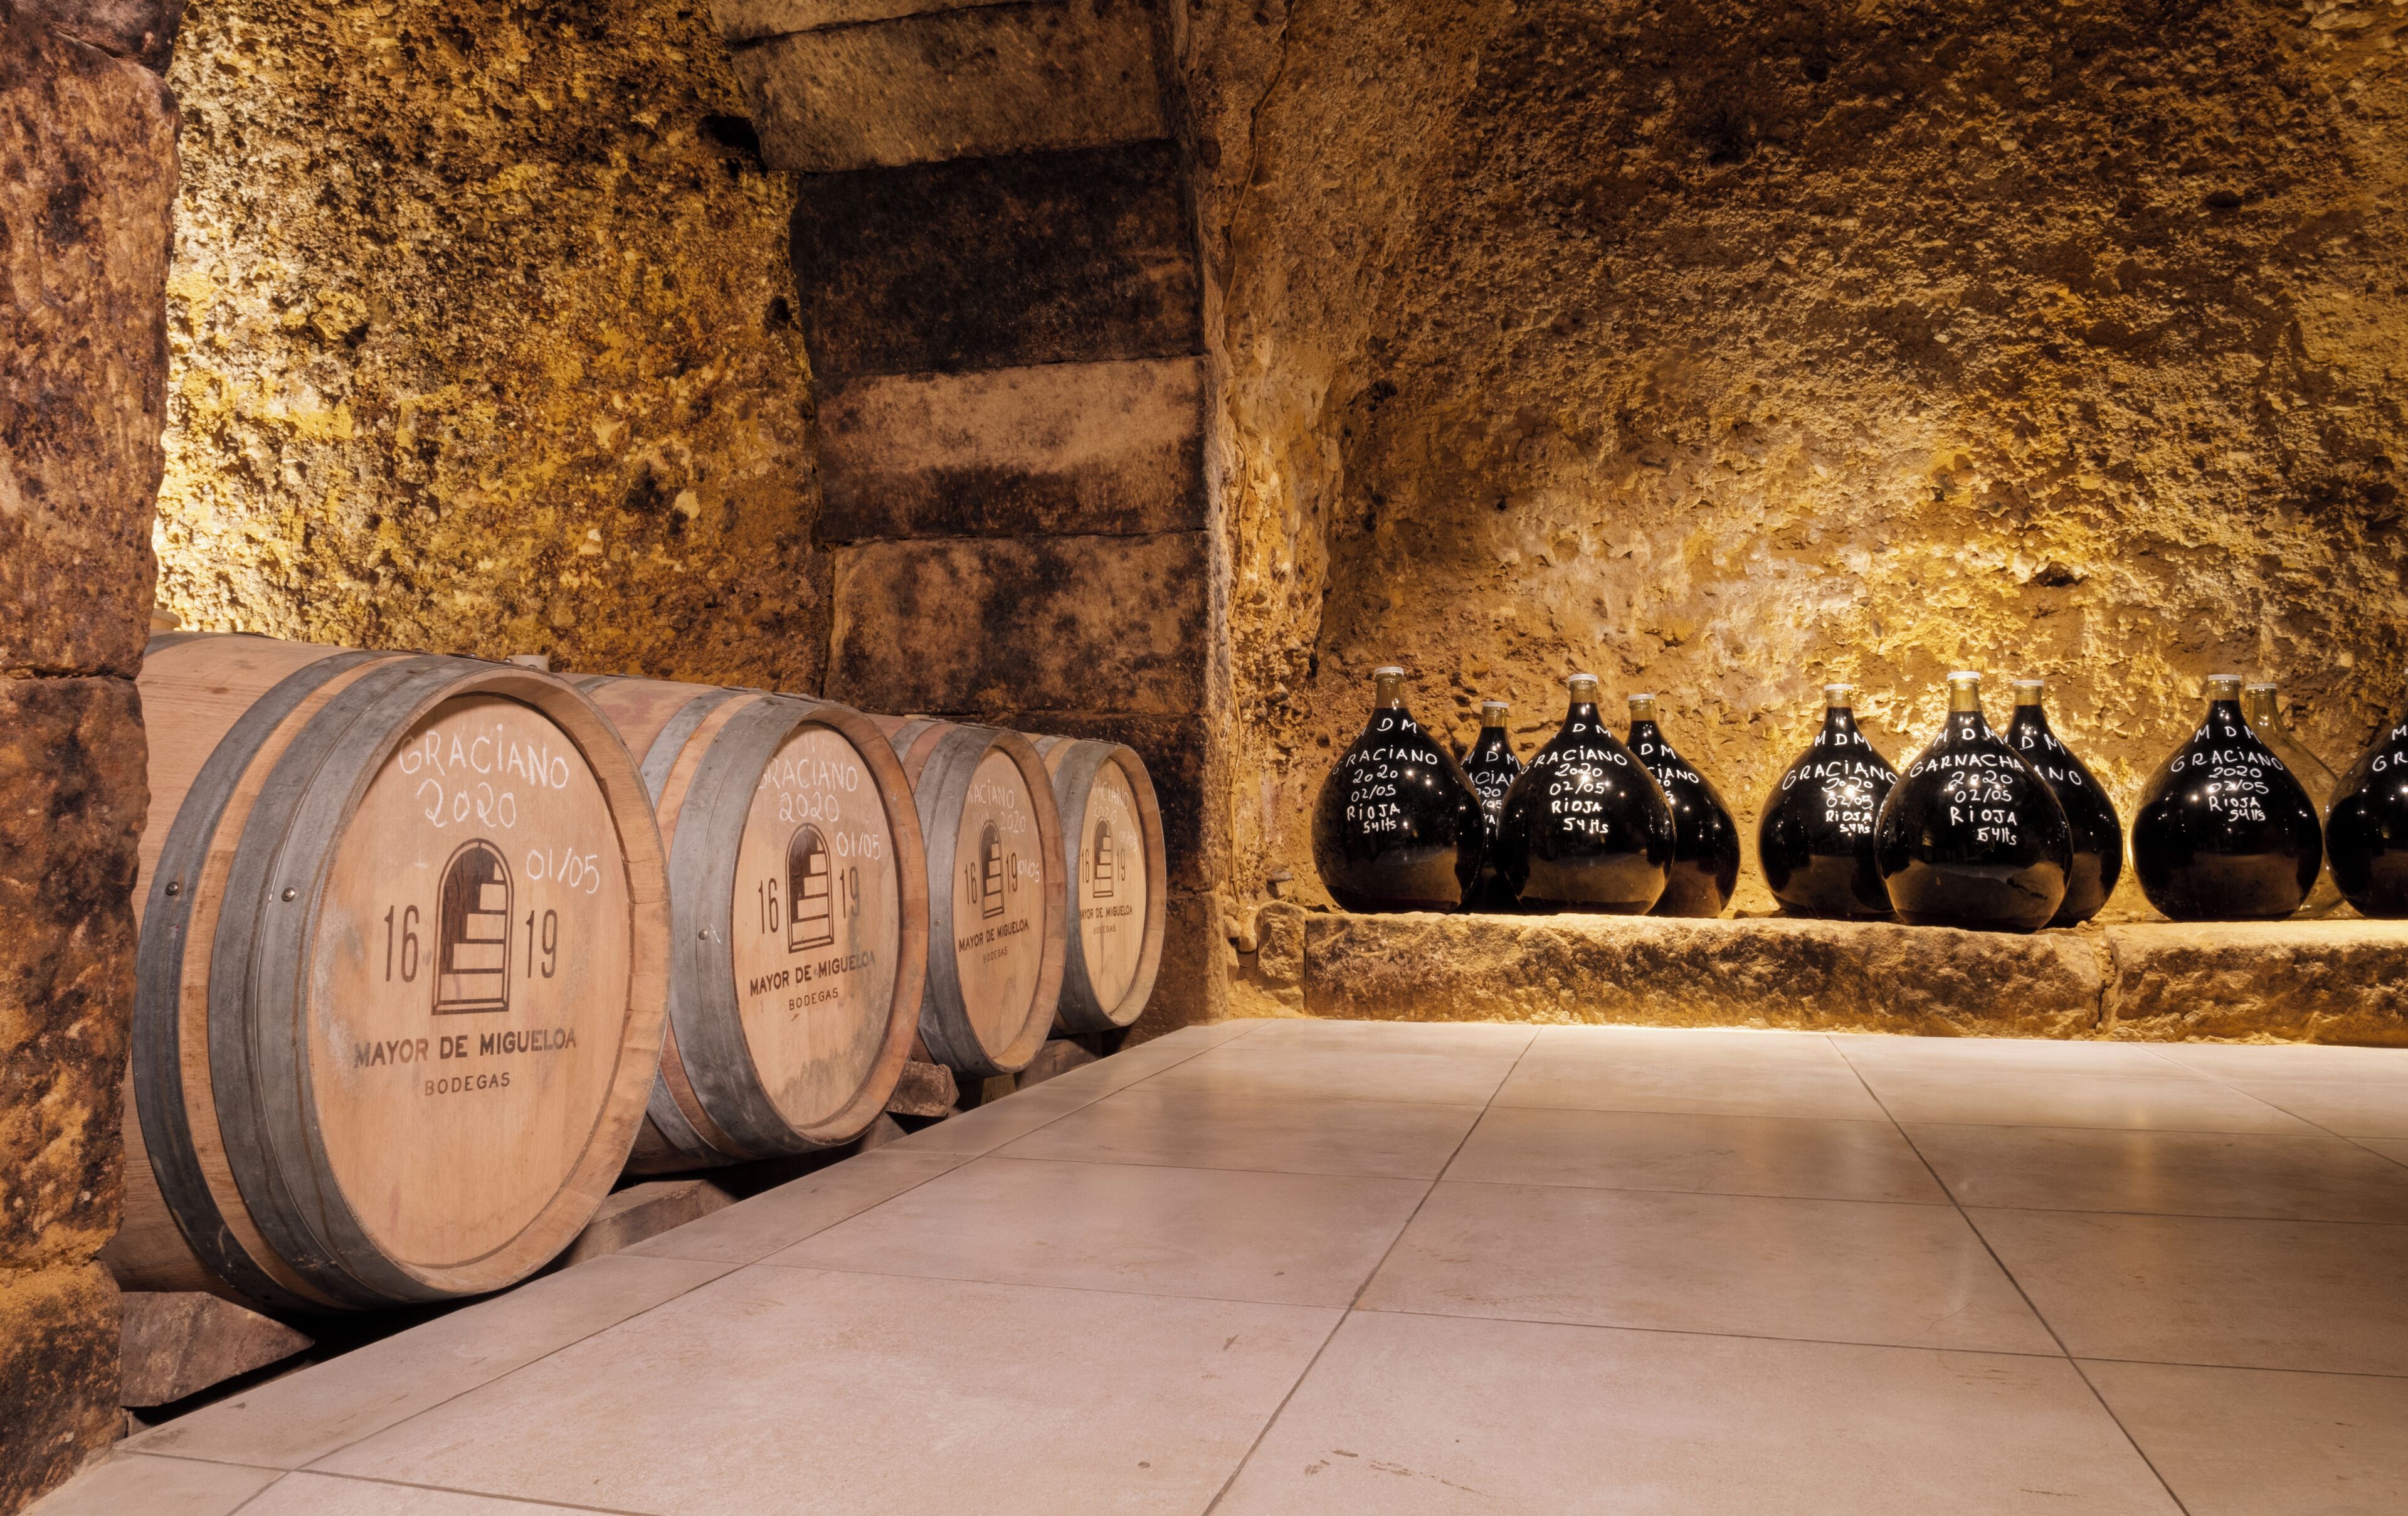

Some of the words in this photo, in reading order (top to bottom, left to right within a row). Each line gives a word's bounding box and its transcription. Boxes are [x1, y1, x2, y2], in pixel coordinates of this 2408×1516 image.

[1353, 764, 1398, 783] 2020
[1555, 763, 1603, 777] 2020
[1909, 754, 2025, 778] GARNACHA
[1948, 770, 2013, 785] 2020
[2209, 766, 2262, 778] 2020
[1351, 784, 1397, 802] 02/05
[1550, 781, 1605, 795] 02/05
[1821, 777, 1873, 793] 2020
[1955, 788, 2012, 803] 02/05
[2207, 779, 2269, 794] 02/05
[417, 778, 517, 828] 2020
[779, 792, 839, 822] 2020
[1826, 795, 1874, 810] 02/05
[1000, 810, 1026, 834] 2020
[837, 832, 880, 860] 01/05
[526, 847, 599, 894] 01/05
[1081, 849, 1090, 883] 16
[1116, 848, 1126, 882] 19
[964, 861, 978, 905] 16
[1005, 852, 1018, 894] 19
[758, 877, 779, 934] 16
[839, 866, 861, 920] 19
[1096, 907, 1104, 918] DE
[1106, 905, 1133, 918] MIGUELOA
[383, 904, 420, 983] 16
[525, 908, 559, 978] 19
[959, 932, 984, 953] MAYOR
[986, 928, 995, 943] DE
[997, 918, 1029, 940] MIGUELOA
[983, 946, 1008, 964] BODEGAS
[749, 970, 789, 997] MAYOR
[795, 964, 813, 983] DE
[818, 950, 876, 978] MIGUELOA
[788, 987, 839, 1011] BODEGAS
[354, 1038, 429, 1068] MAYOR
[440, 1035, 468, 1060] DE
[479, 1027, 577, 1057] MIGUELOA
[425, 1072, 510, 1096] BODEGAS
